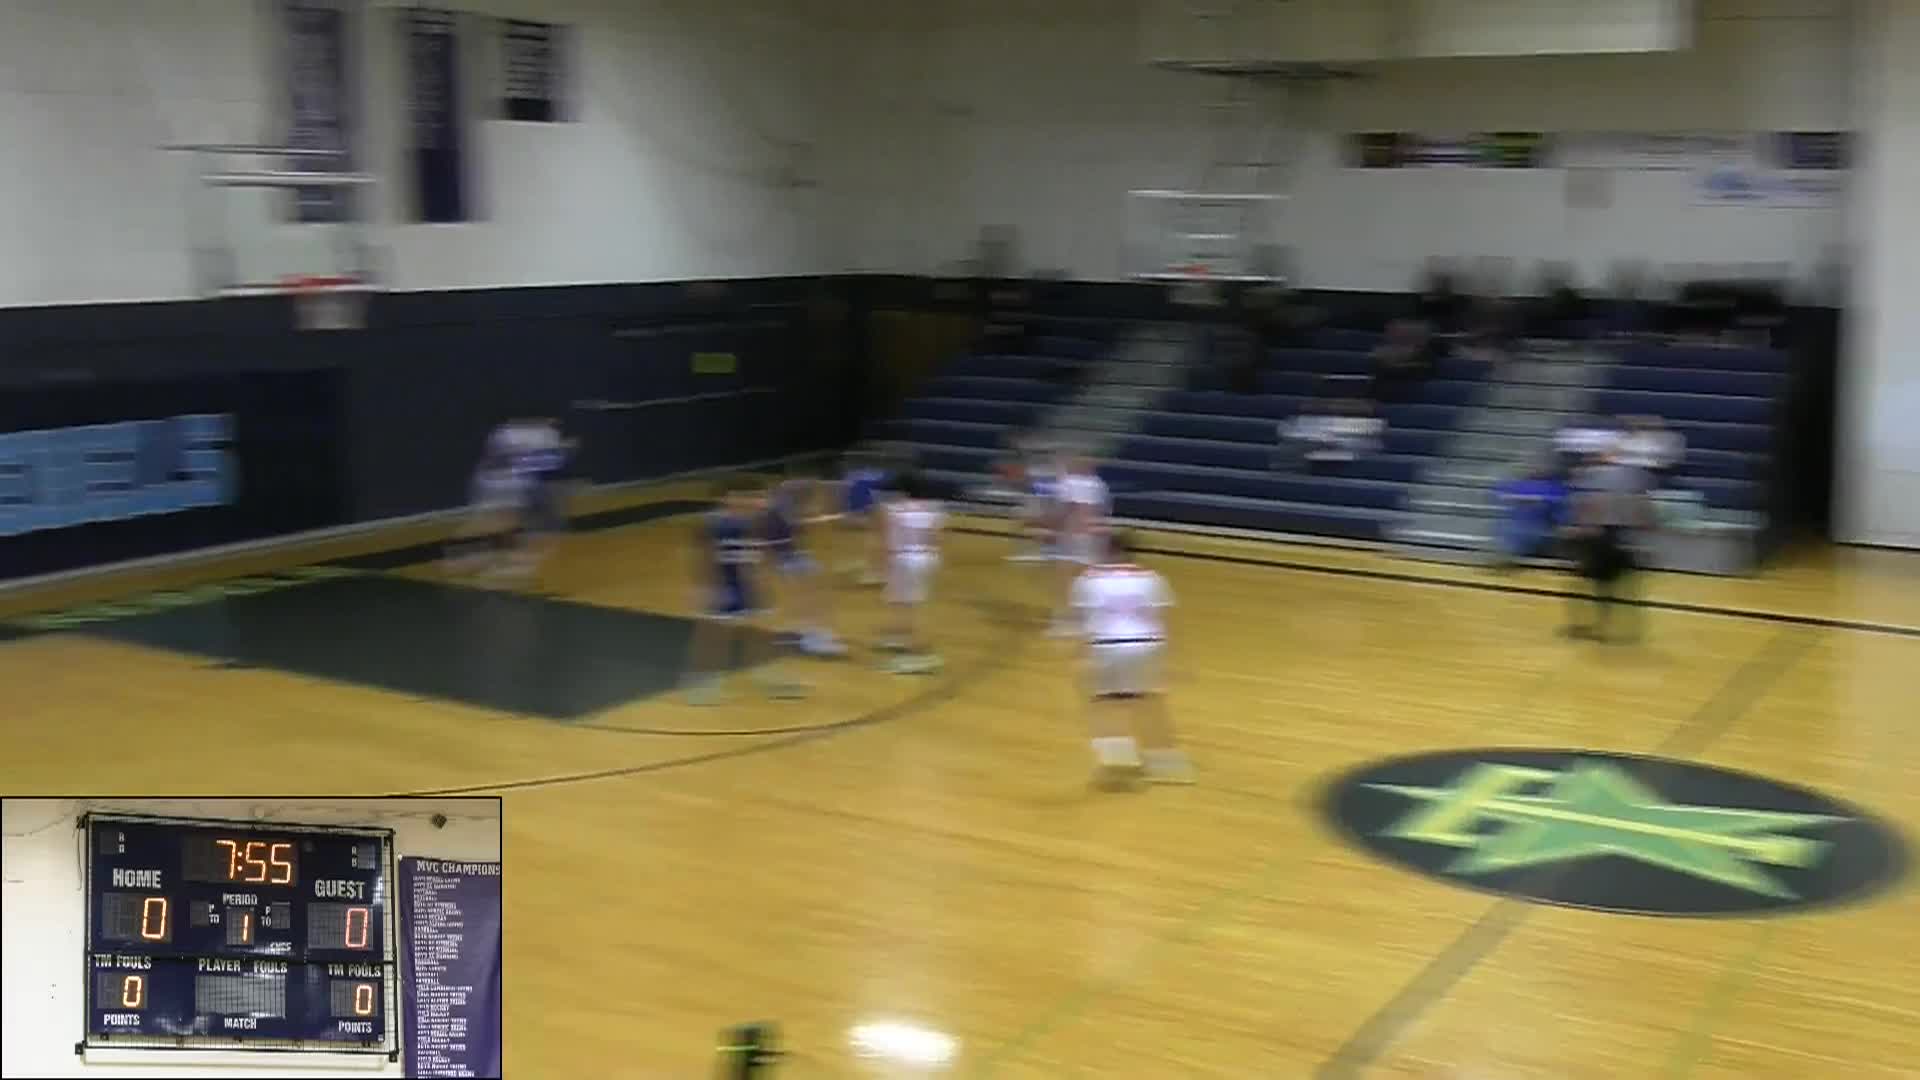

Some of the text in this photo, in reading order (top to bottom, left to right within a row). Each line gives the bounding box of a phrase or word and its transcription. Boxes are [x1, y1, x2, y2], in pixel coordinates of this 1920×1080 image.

[216, 839, 292, 884] 7:55
[416, 860, 500, 875] MVC CHAMPIONS
[113, 868, 162, 888] HOME
[314, 879, 366, 899] GUEST
[222, 893, 257, 906] PERIOD
[142, 897, 167, 939] 0
[241, 912, 250, 942] 1
[345, 907, 368, 948] 0
[94, 954, 152, 969] TM FOULS
[199, 958, 241, 972] PLAYER
[328, 964, 344, 977] TM
[123, 975, 142, 1007] 0
[355, 984, 372, 1014] 0
[103, 1013, 140, 1026] POINTS
[224, 1017, 257, 1029] MATCH
[338, 1020, 372, 1033] POINTS
